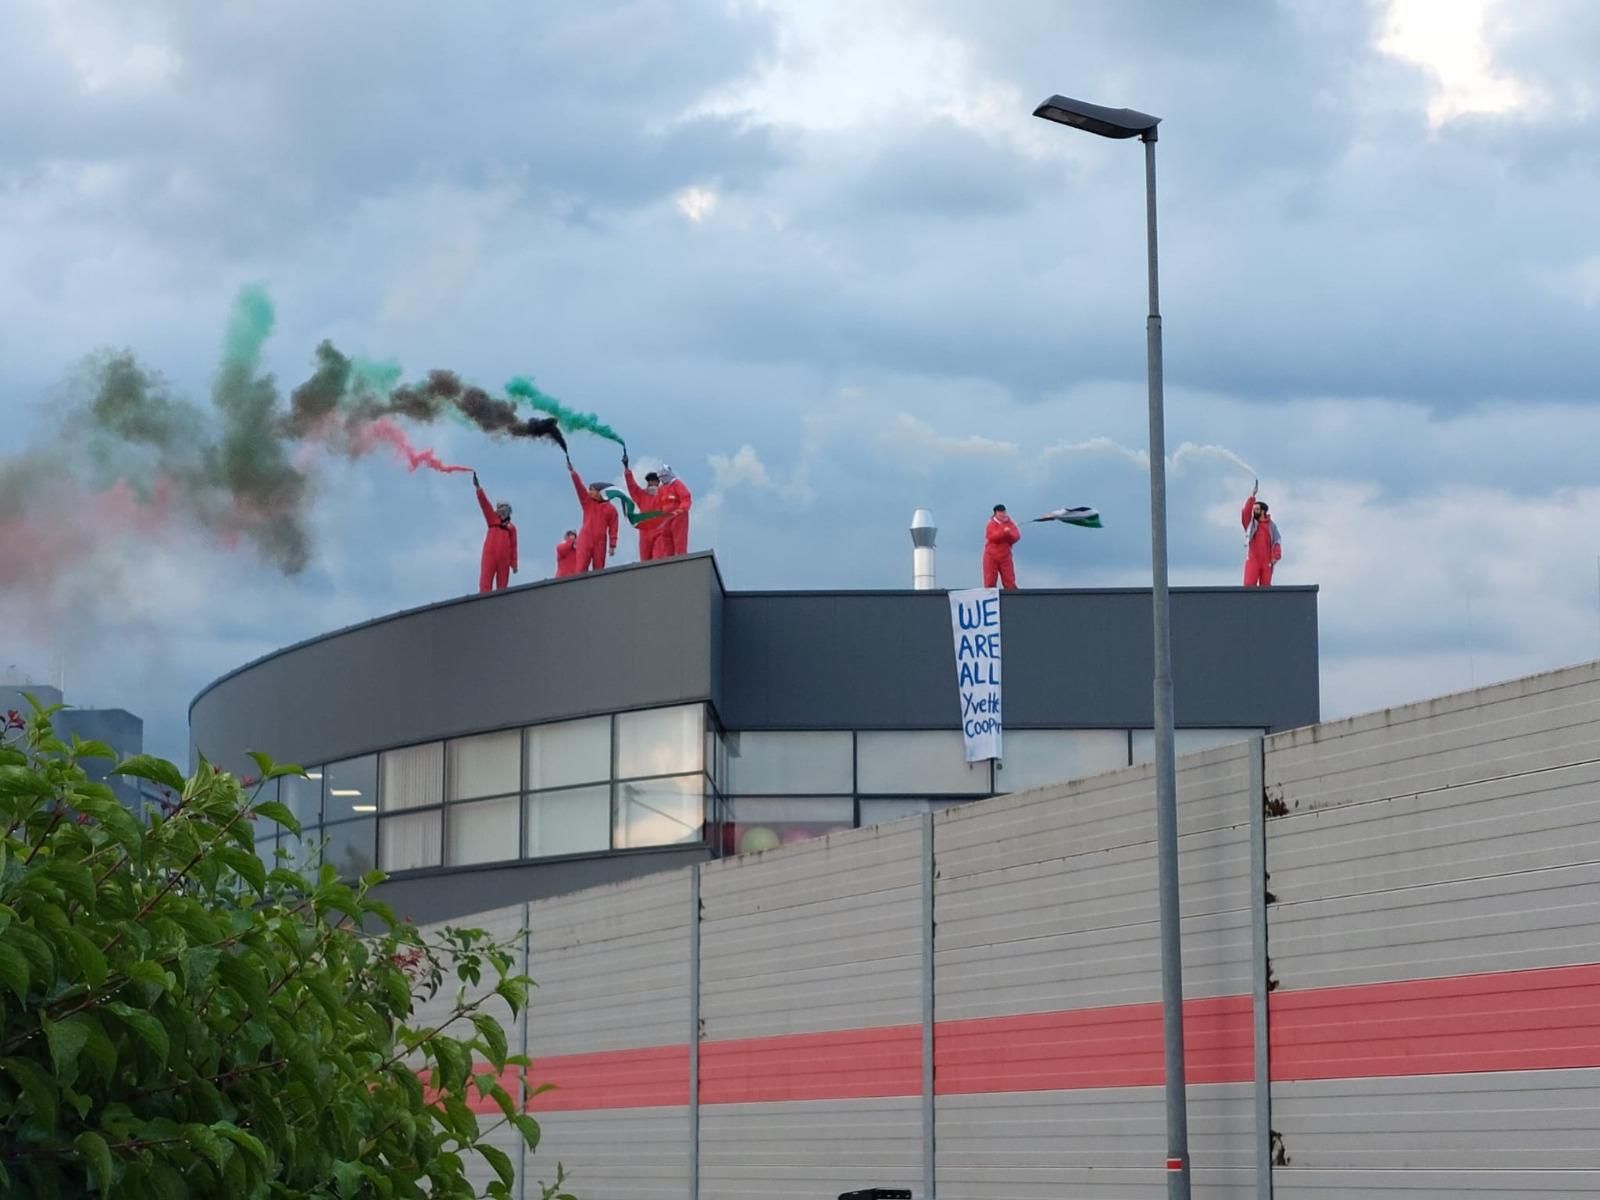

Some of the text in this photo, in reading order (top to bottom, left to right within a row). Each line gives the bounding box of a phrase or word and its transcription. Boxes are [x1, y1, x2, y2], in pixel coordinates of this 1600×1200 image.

[959, 597, 998, 630] WE
[959, 633, 1000, 660] ARE
[960, 661, 999, 687] ALL
